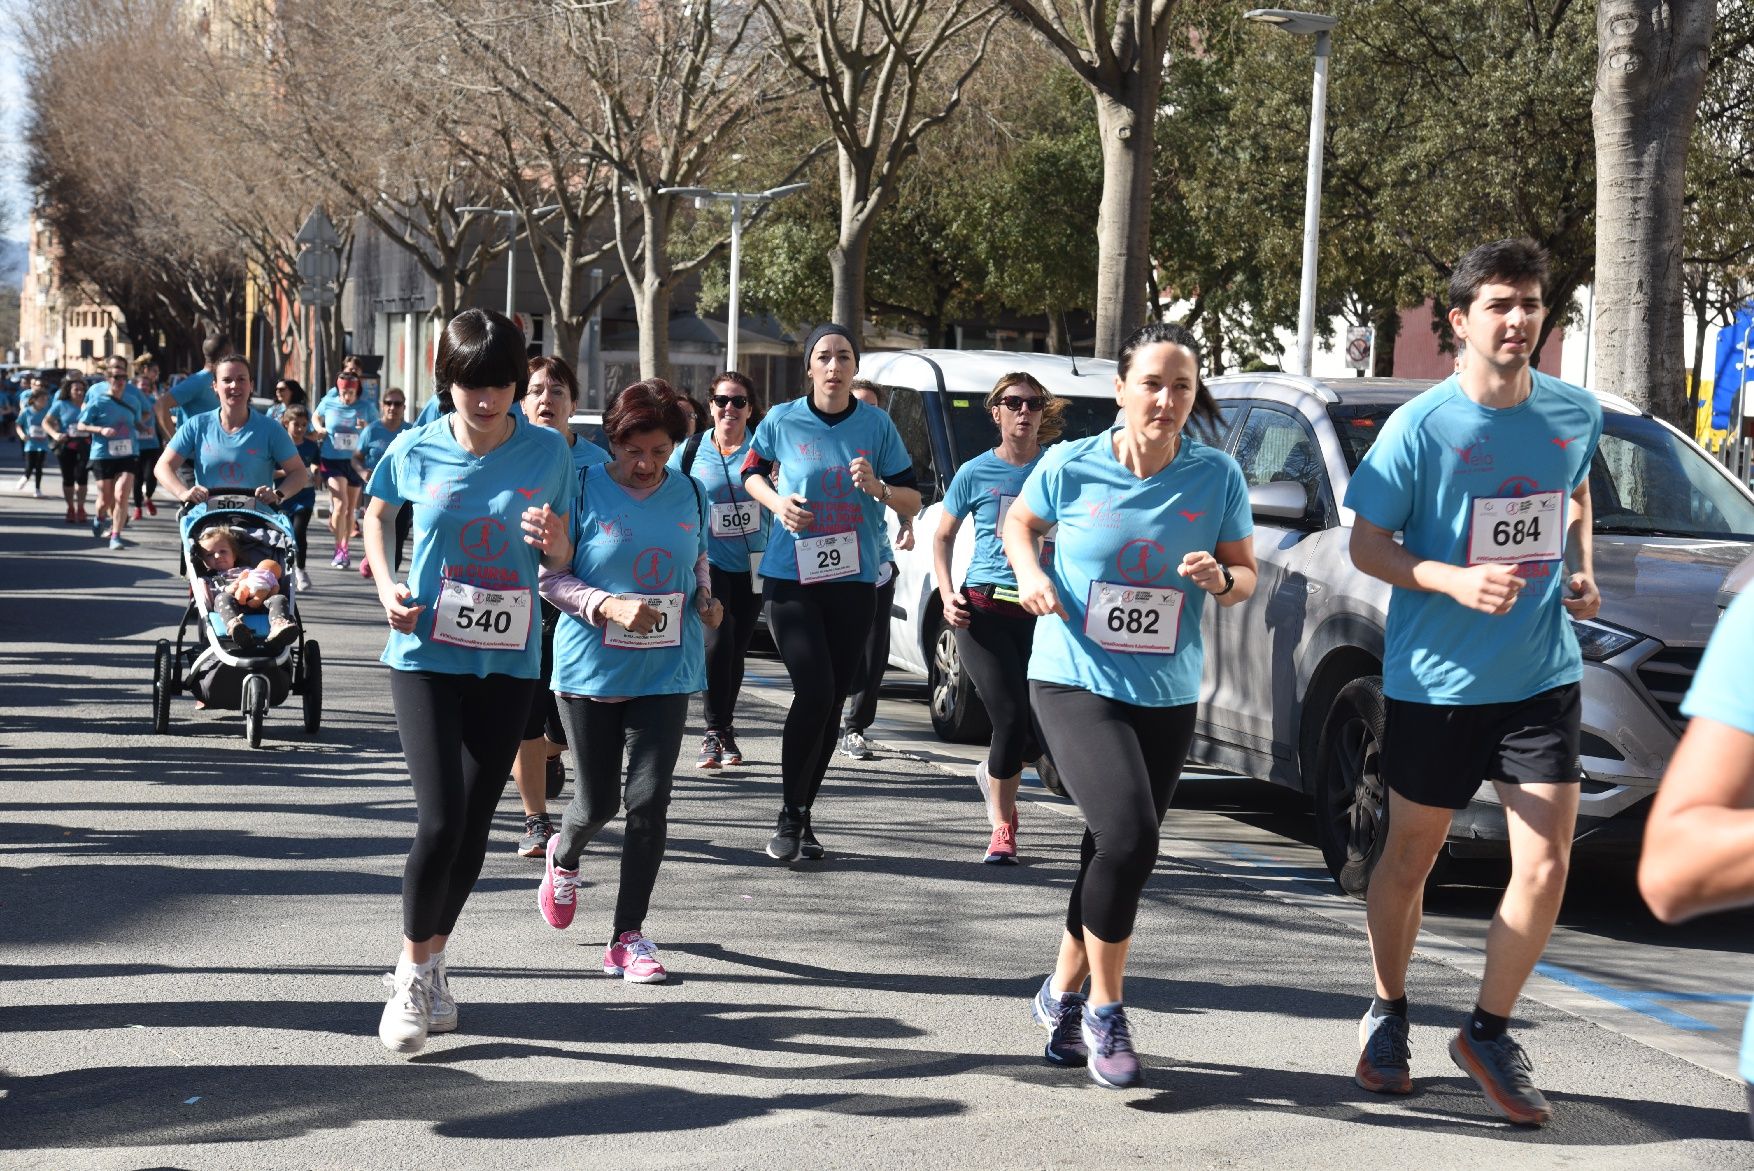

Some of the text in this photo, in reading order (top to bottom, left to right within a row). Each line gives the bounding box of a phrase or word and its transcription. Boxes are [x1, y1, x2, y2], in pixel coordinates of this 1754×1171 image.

[217, 500, 245, 509] 502
[722, 512, 751, 528] 509
[1493, 516, 1541, 546] 684
[816, 549, 841, 568] 29
[467, 563, 520, 583] CURSA
[455, 606, 512, 633] 540
[1107, 607, 1160, 634] 682
